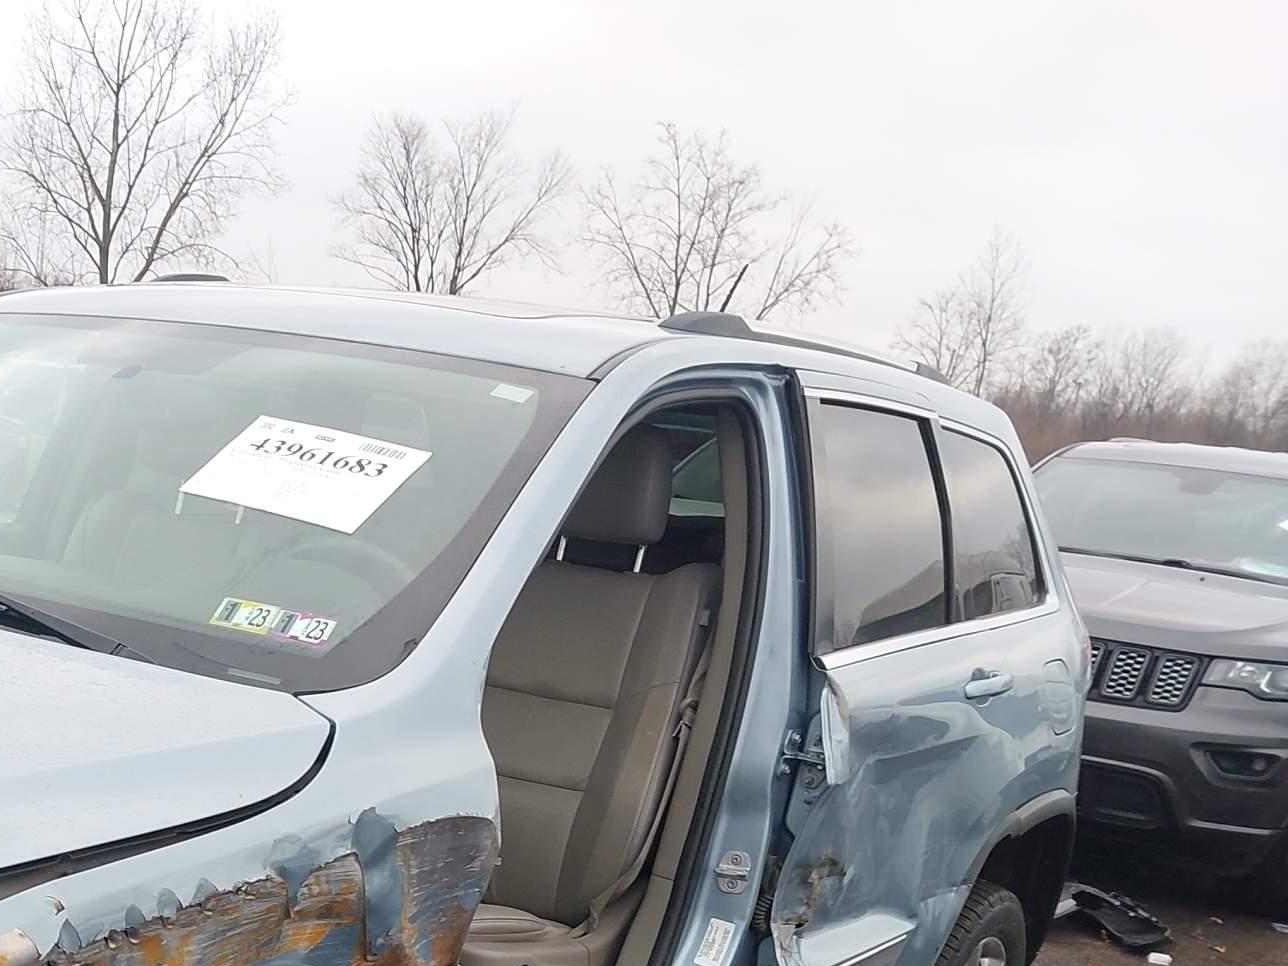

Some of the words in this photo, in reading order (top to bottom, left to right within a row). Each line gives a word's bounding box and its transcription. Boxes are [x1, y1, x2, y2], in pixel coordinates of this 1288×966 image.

[250, 436, 389, 478] 43961683
[247, 607, 272, 628] 23
[305, 619, 329, 641] 23
